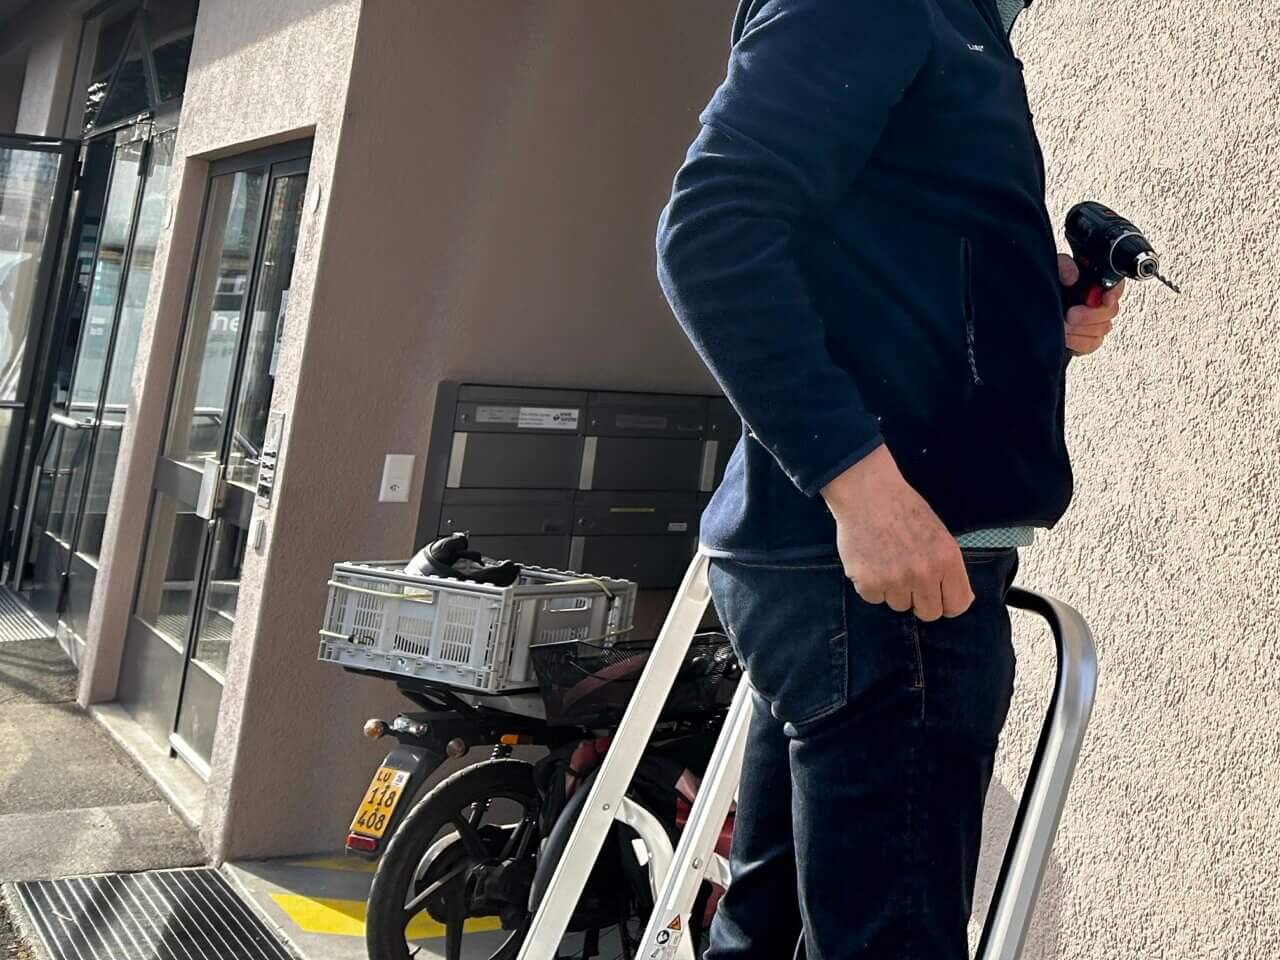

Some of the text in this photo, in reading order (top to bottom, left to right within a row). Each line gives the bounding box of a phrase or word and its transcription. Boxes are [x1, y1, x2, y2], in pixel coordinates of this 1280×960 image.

[377, 770, 393, 783] LU
[367, 787, 397, 808] 118
[357, 810, 387, 832] 408
